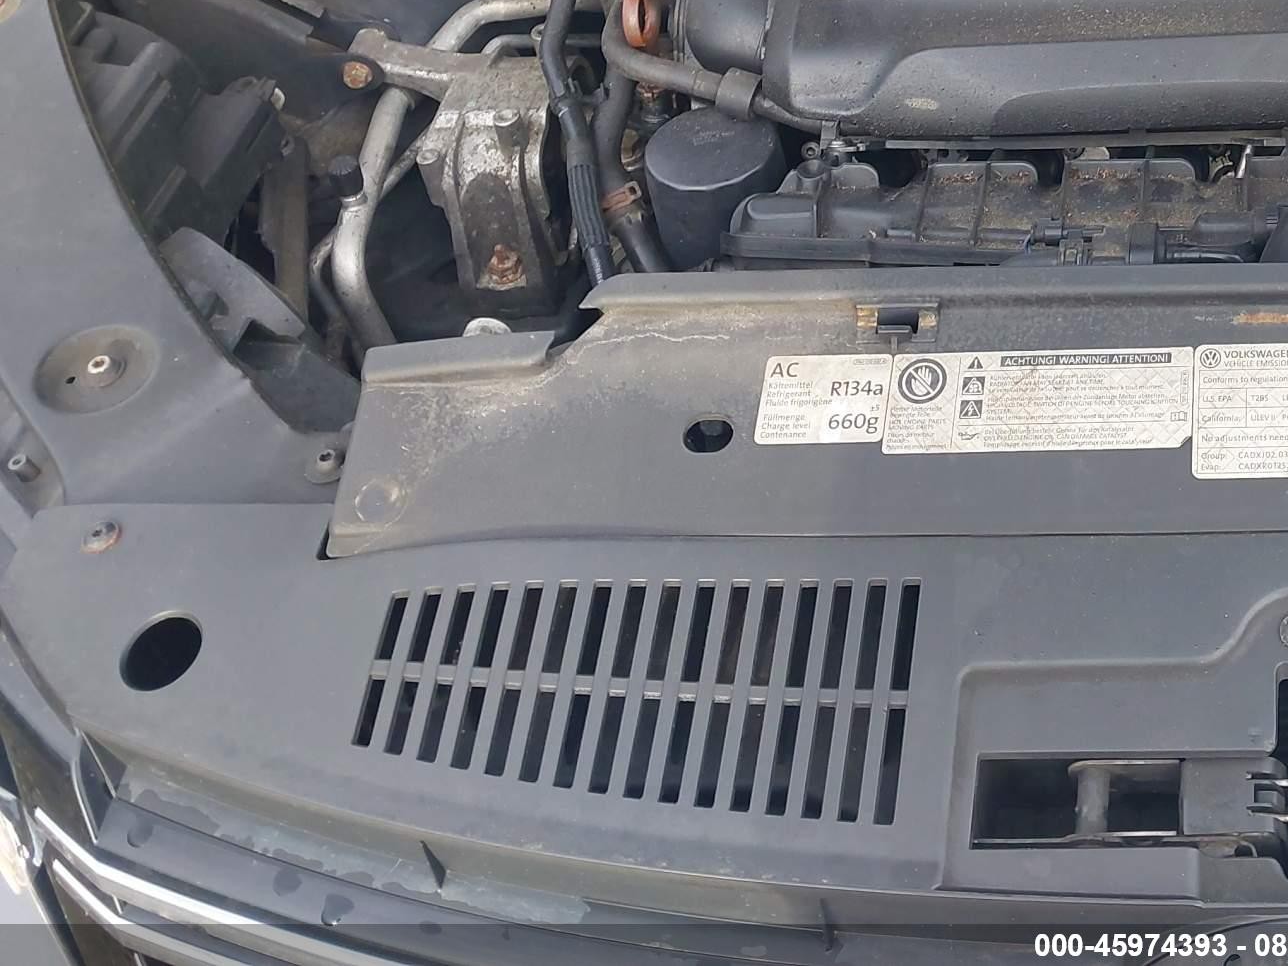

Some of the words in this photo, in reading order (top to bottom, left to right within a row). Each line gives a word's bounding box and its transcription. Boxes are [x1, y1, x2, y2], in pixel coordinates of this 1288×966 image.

[1004, 355, 1056, 366] ACHTUNG!
[1058, 354, 1110, 365] WARNING!
[1111, 353, 1169, 364] ATTENTION!
[770, 362, 800, 378] AC
[1202, 376, 1239, 384] Conforms
[830, 380, 884, 396] R134a
[761, 422, 791, 432] Charge
[792, 422, 812, 430] level
[828, 413, 879, 435] 660g
[760, 431, 808, 439] Contenance
[1214, 434, 1267, 443] adjustments
